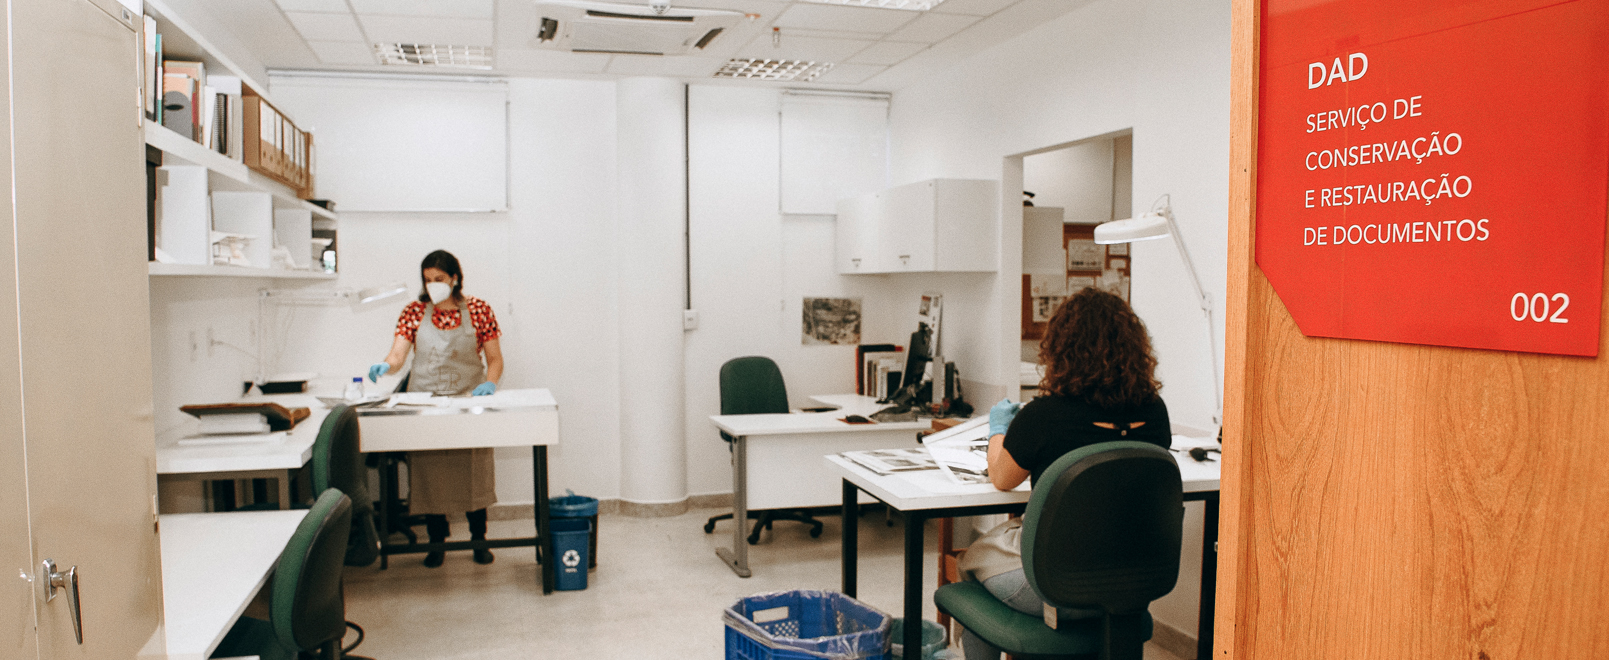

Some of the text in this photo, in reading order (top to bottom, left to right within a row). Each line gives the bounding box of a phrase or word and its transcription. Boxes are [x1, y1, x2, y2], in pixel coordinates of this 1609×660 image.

[1307, 52, 1369, 90] DAD
[1305, 96, 1422, 134] SERVIÇO DE
[1305, 131, 1463, 171] CONSERVAÇÃO
[1305, 173, 1473, 209] E RESTAURAÇÃO
[1303, 218, 1490, 246] DE DOCUMENTOS
[1510, 292, 1570, 324] 002
